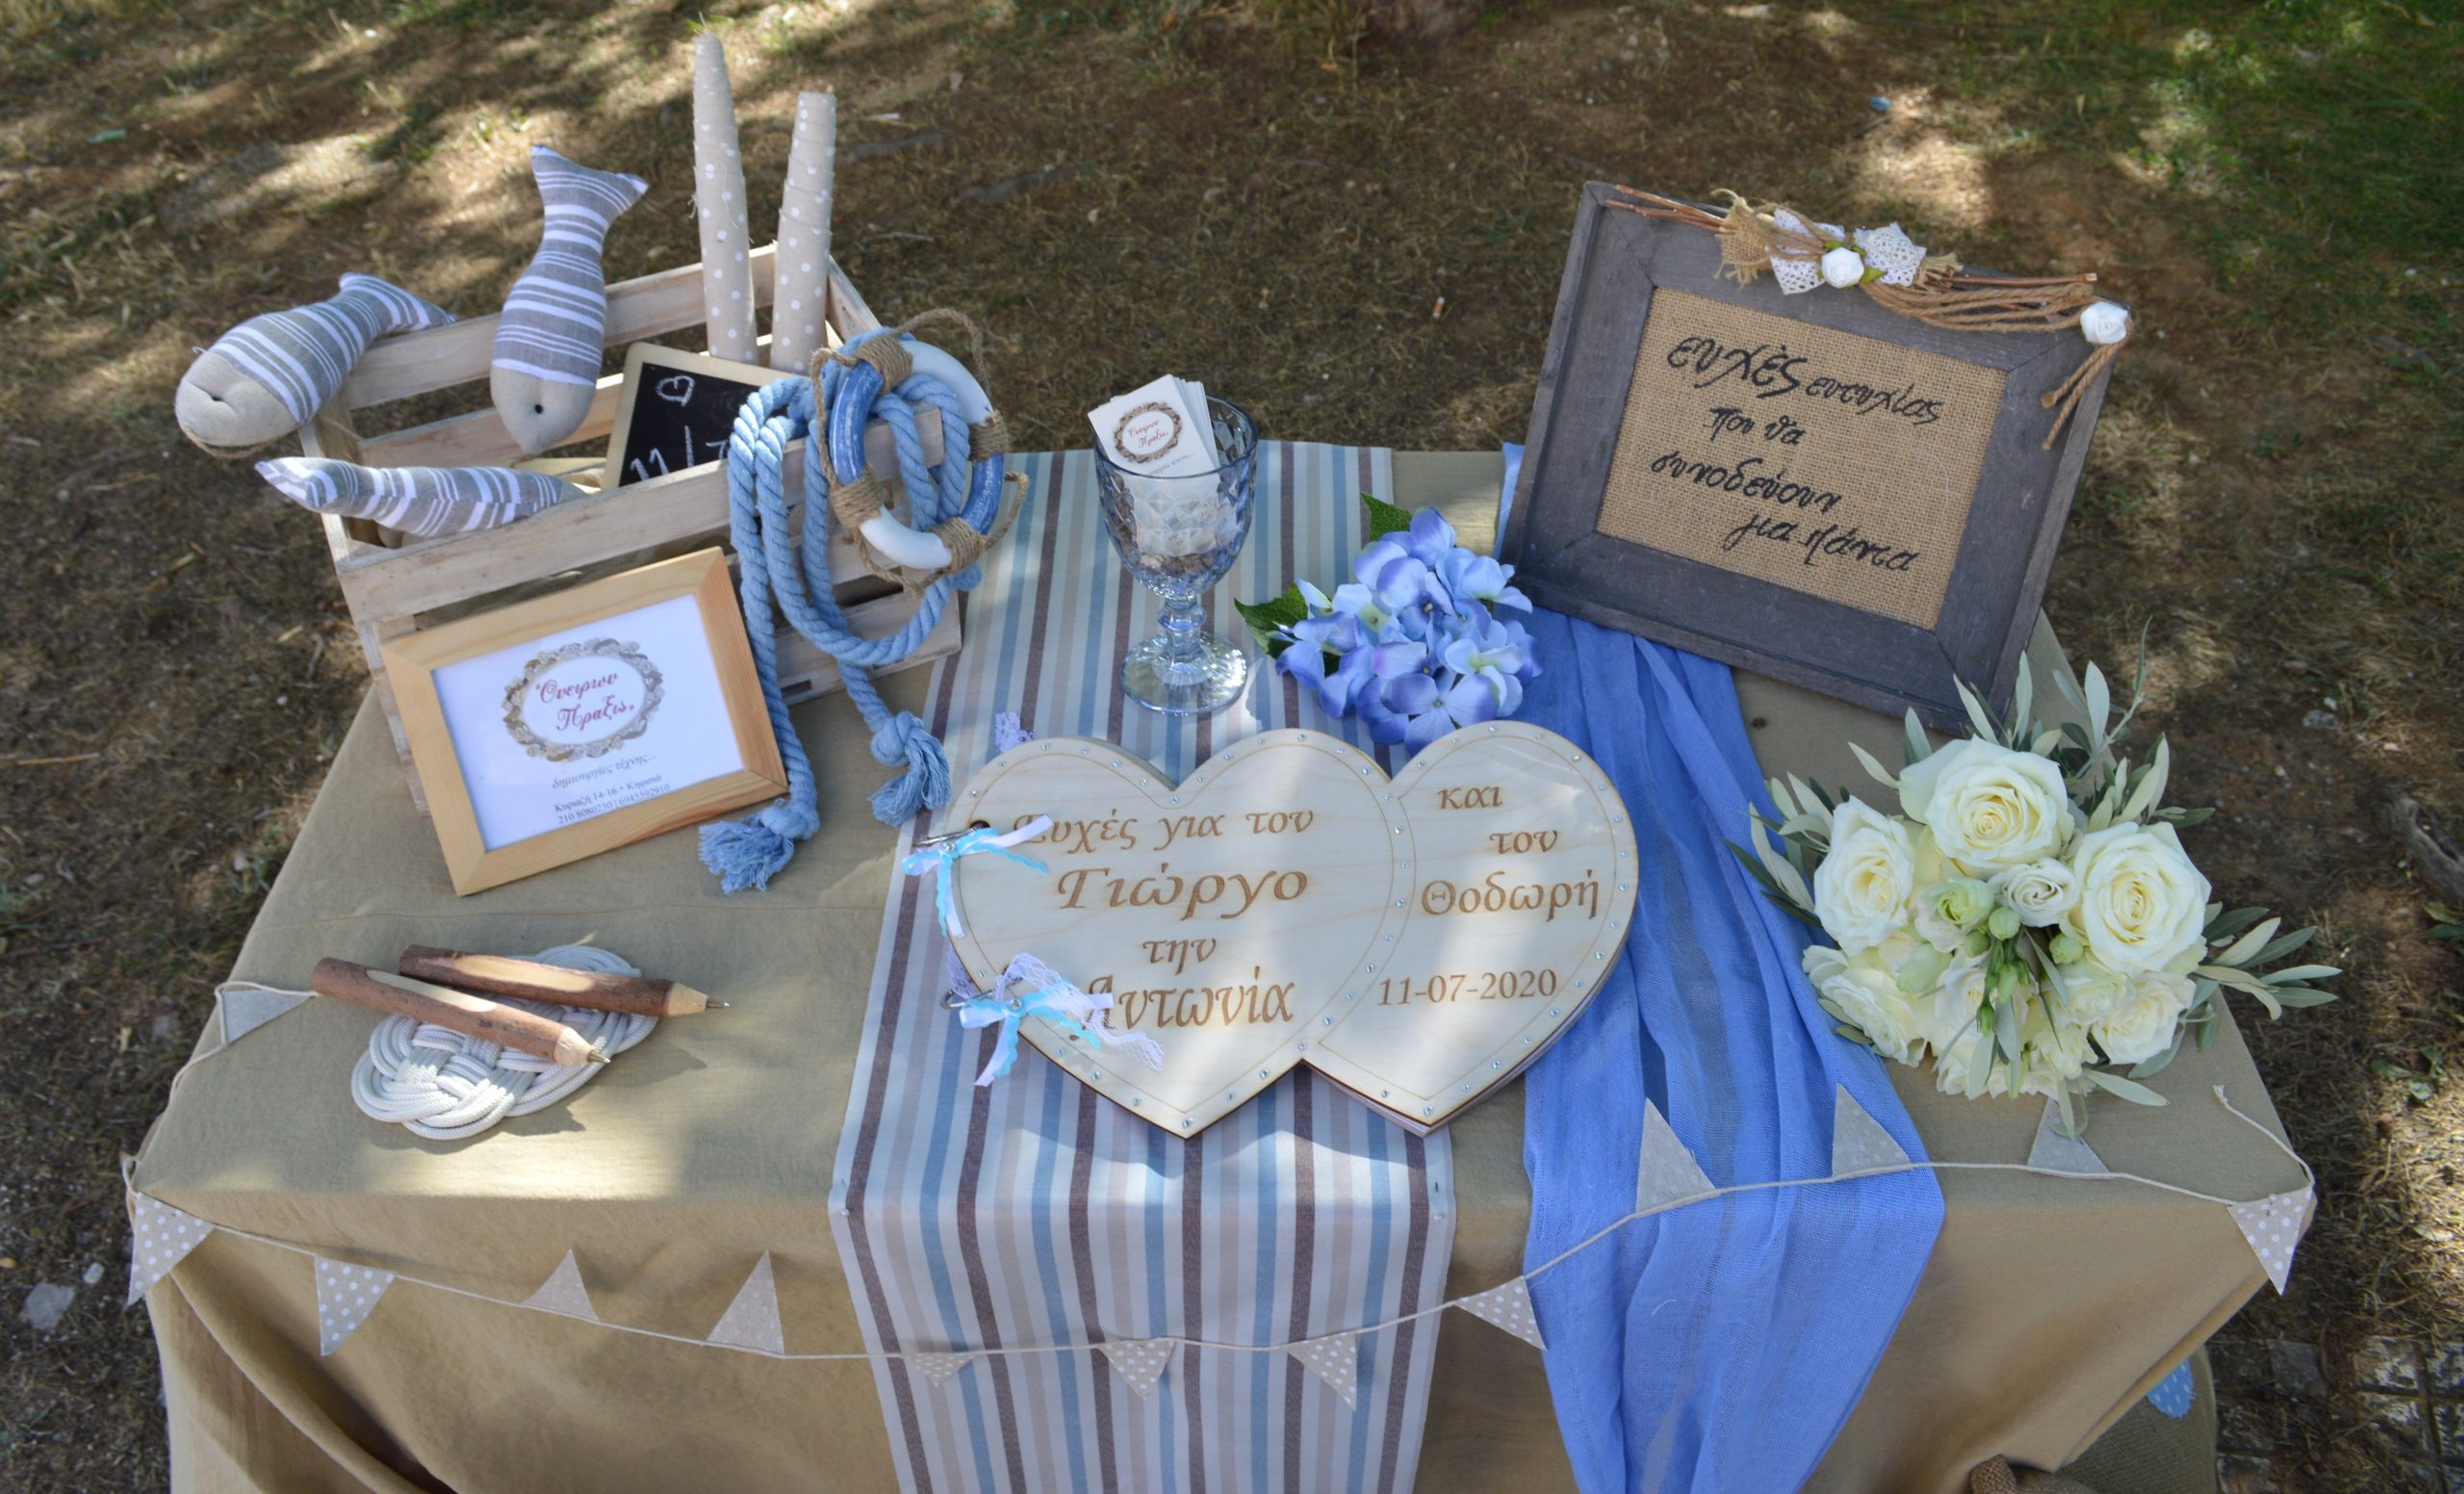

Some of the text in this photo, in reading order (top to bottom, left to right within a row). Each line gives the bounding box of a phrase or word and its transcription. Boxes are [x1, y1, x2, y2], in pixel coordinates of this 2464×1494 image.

[1667, 337, 1808, 399] ευχές
[1723, 513, 1798, 551] για
[1437, 786, 1503, 810] και
[1153, 813, 1225, 851] για
[1245, 811, 1314, 834] τον
[1489, 830, 1557, 855] τον
[1058, 862, 1309, 921] Γιώργο
[1421, 868, 1599, 922] Θοδωρή
[1142, 938, 1217, 976] την
[1377, 968, 1557, 1006] 11-07-2020
